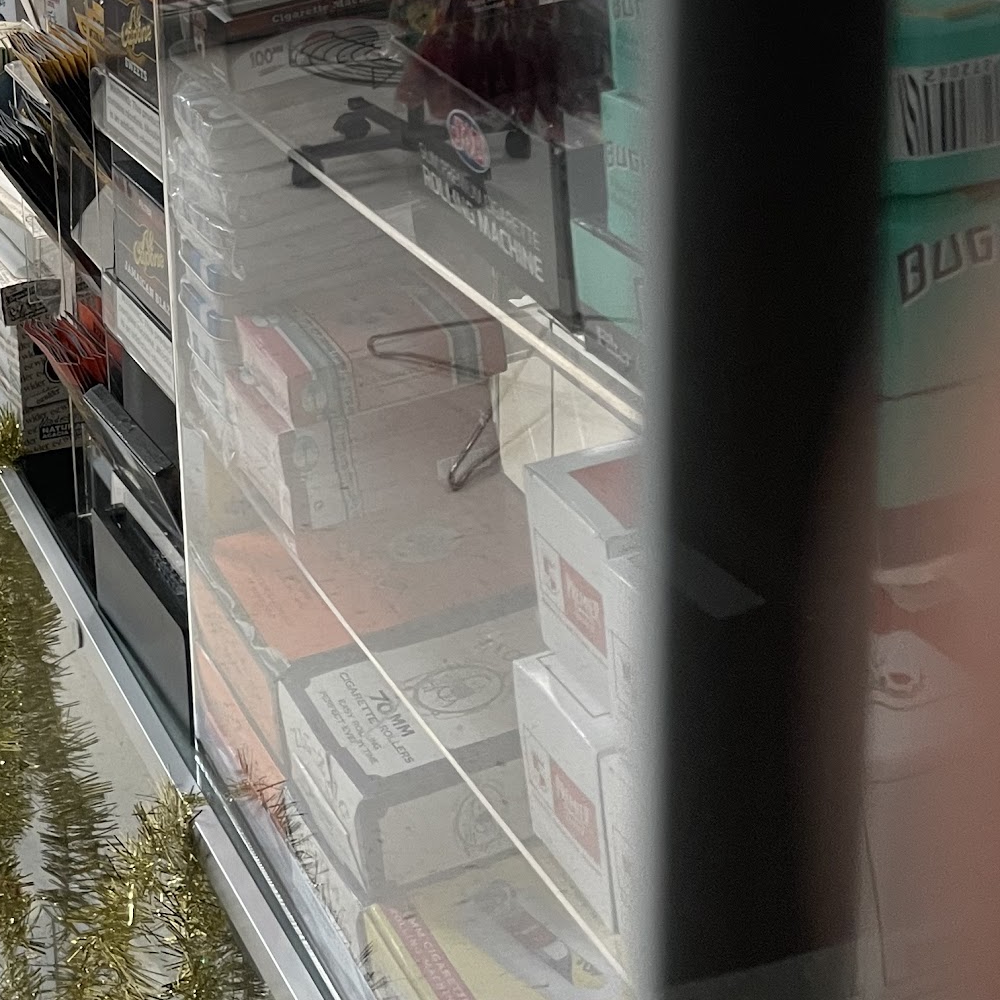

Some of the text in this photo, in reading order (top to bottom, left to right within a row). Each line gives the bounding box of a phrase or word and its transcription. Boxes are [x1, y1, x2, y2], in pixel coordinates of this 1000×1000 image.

[124, 56, 148, 82] SWEETS
[476, 209, 545, 283] MACHINE
[897, 224, 995, 307] BUG
[340, 671, 415, 764] CIGARETTE ROLLERS
[369, 690, 416, 738] 70MM
